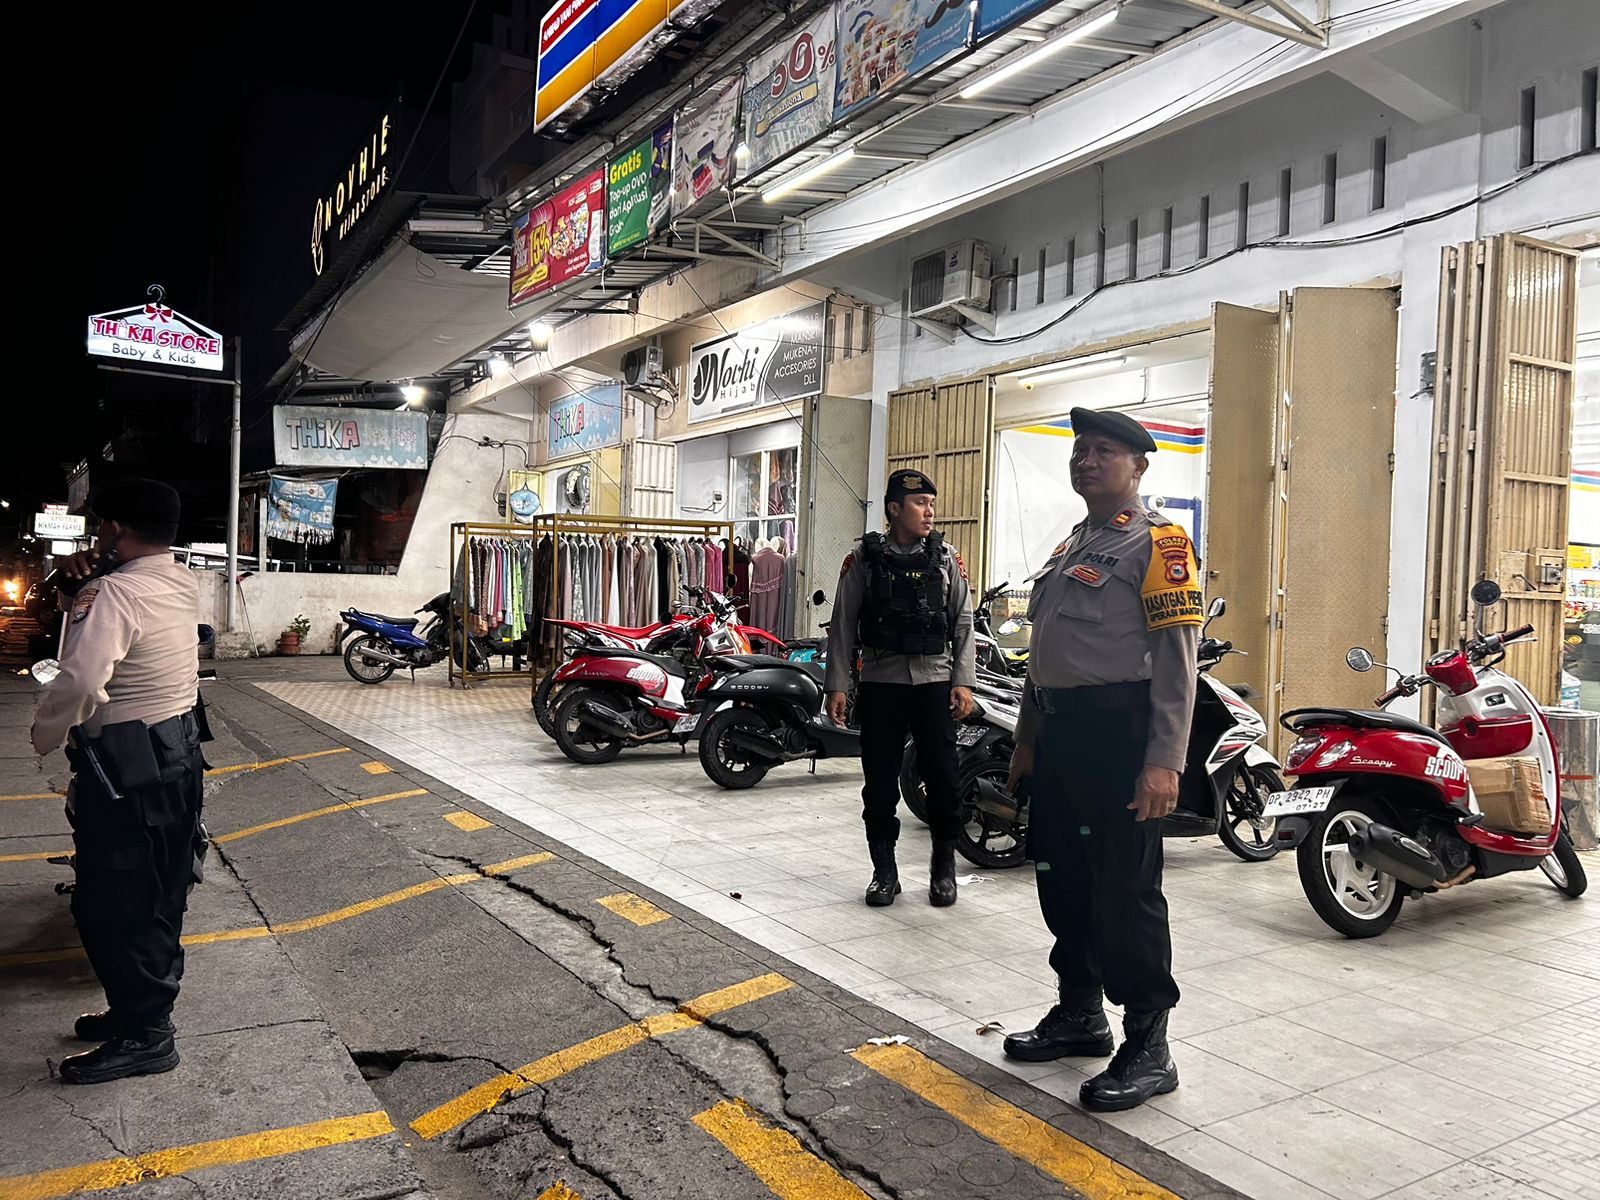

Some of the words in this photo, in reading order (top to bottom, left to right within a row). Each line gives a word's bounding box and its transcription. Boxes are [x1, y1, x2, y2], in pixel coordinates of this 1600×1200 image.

[609, 150, 642, 184] Gratis
[609, 182, 631, 204] Top-up
[631, 171, 647, 191] OVO
[609, 202, 623, 220] dari
[529, 221, 551, 267] 15%
[157, 329, 221, 355] STORE
[112, 342, 147, 360] Baby
[152, 349, 162, 360] &
[168, 351, 196, 365] Kids
[782, 345, 818, 362] MUKENAH
[774, 357, 817, 379] ACCESORIES
[803, 374, 816, 386] DLL
[720, 382, 756, 399] Hijab
[1082, 551, 1120, 567] POLRI
[1349, 755, 1397, 768] Scoopy
[1268, 794, 1281, 805] DP
[1285, 790, 1311, 803] 2942
[1315, 788, 1331, 799] PH
